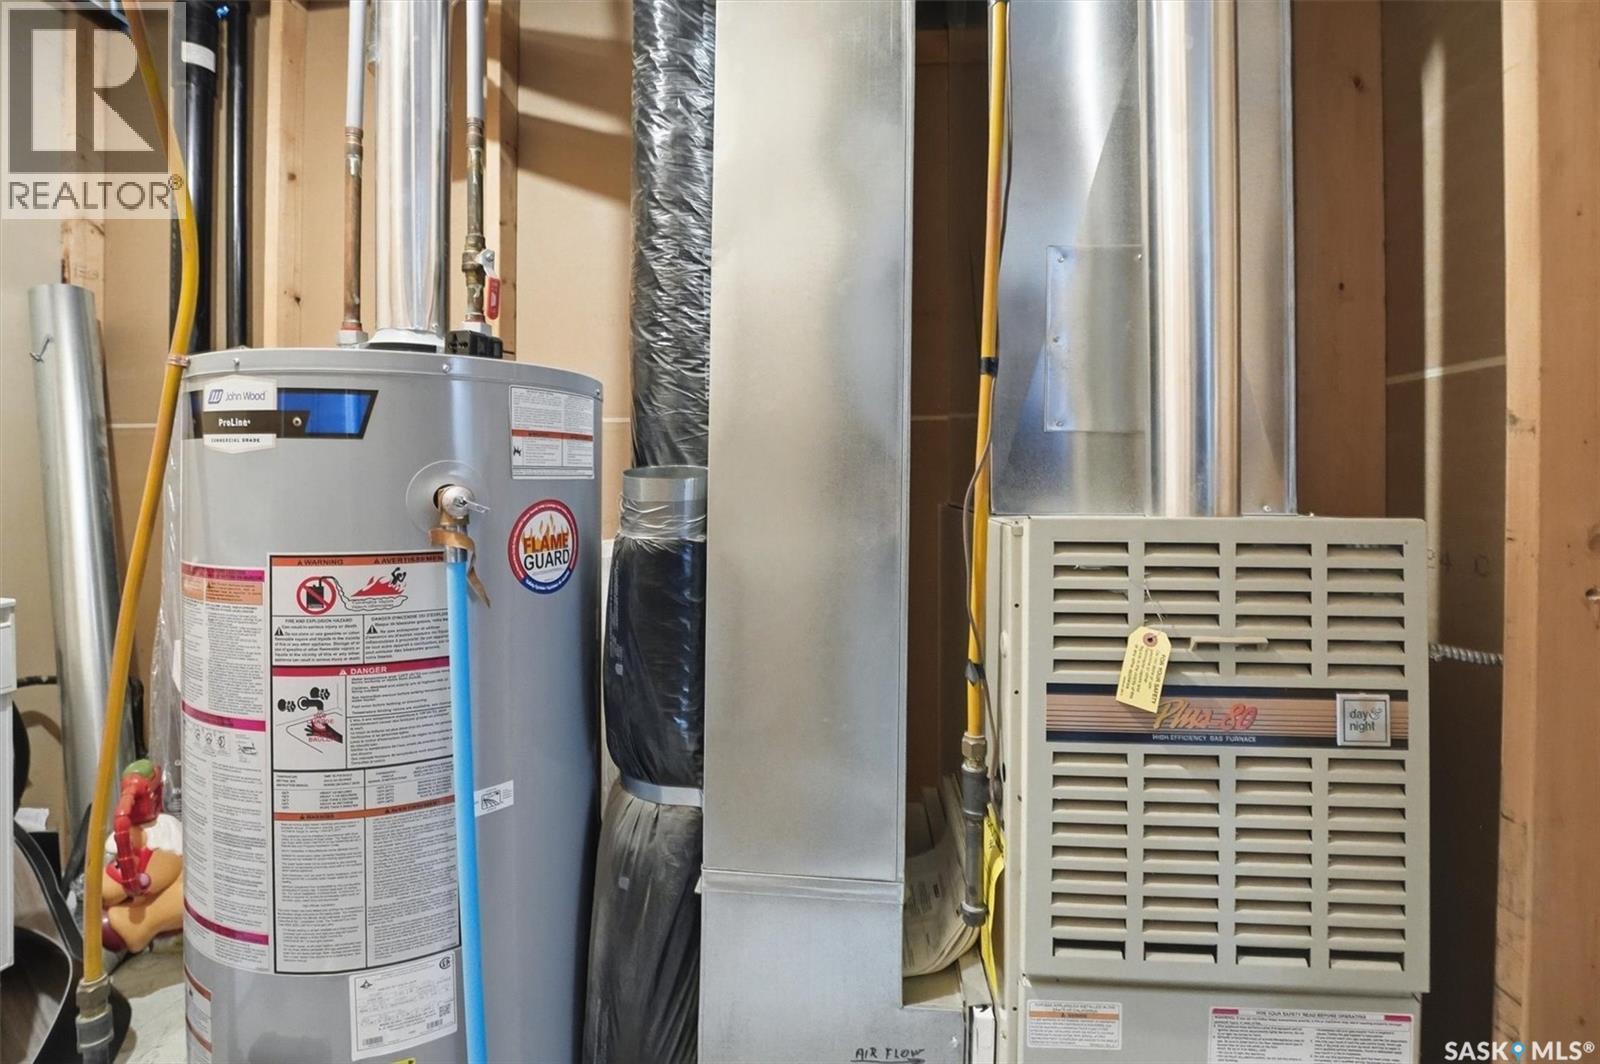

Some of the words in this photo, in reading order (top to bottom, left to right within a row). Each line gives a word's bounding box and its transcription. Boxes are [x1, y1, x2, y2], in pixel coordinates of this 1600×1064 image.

[225, 391, 242, 401] John
[243, 391, 265, 401] Wood
[523, 532, 569, 554] FLAME
[381, 555, 444, 565] AVERTISSEMEN
[524, 549, 570, 571] GUARD
[350, 666, 387, 675] DANGER
[1350, 709, 1368, 721] day
[1350, 721, 1375, 733] night
[1225, 735, 1257, 743] FURNACE
[855, 1047, 878, 1060] AIR
[885, 1047, 925, 1060] FLOW
